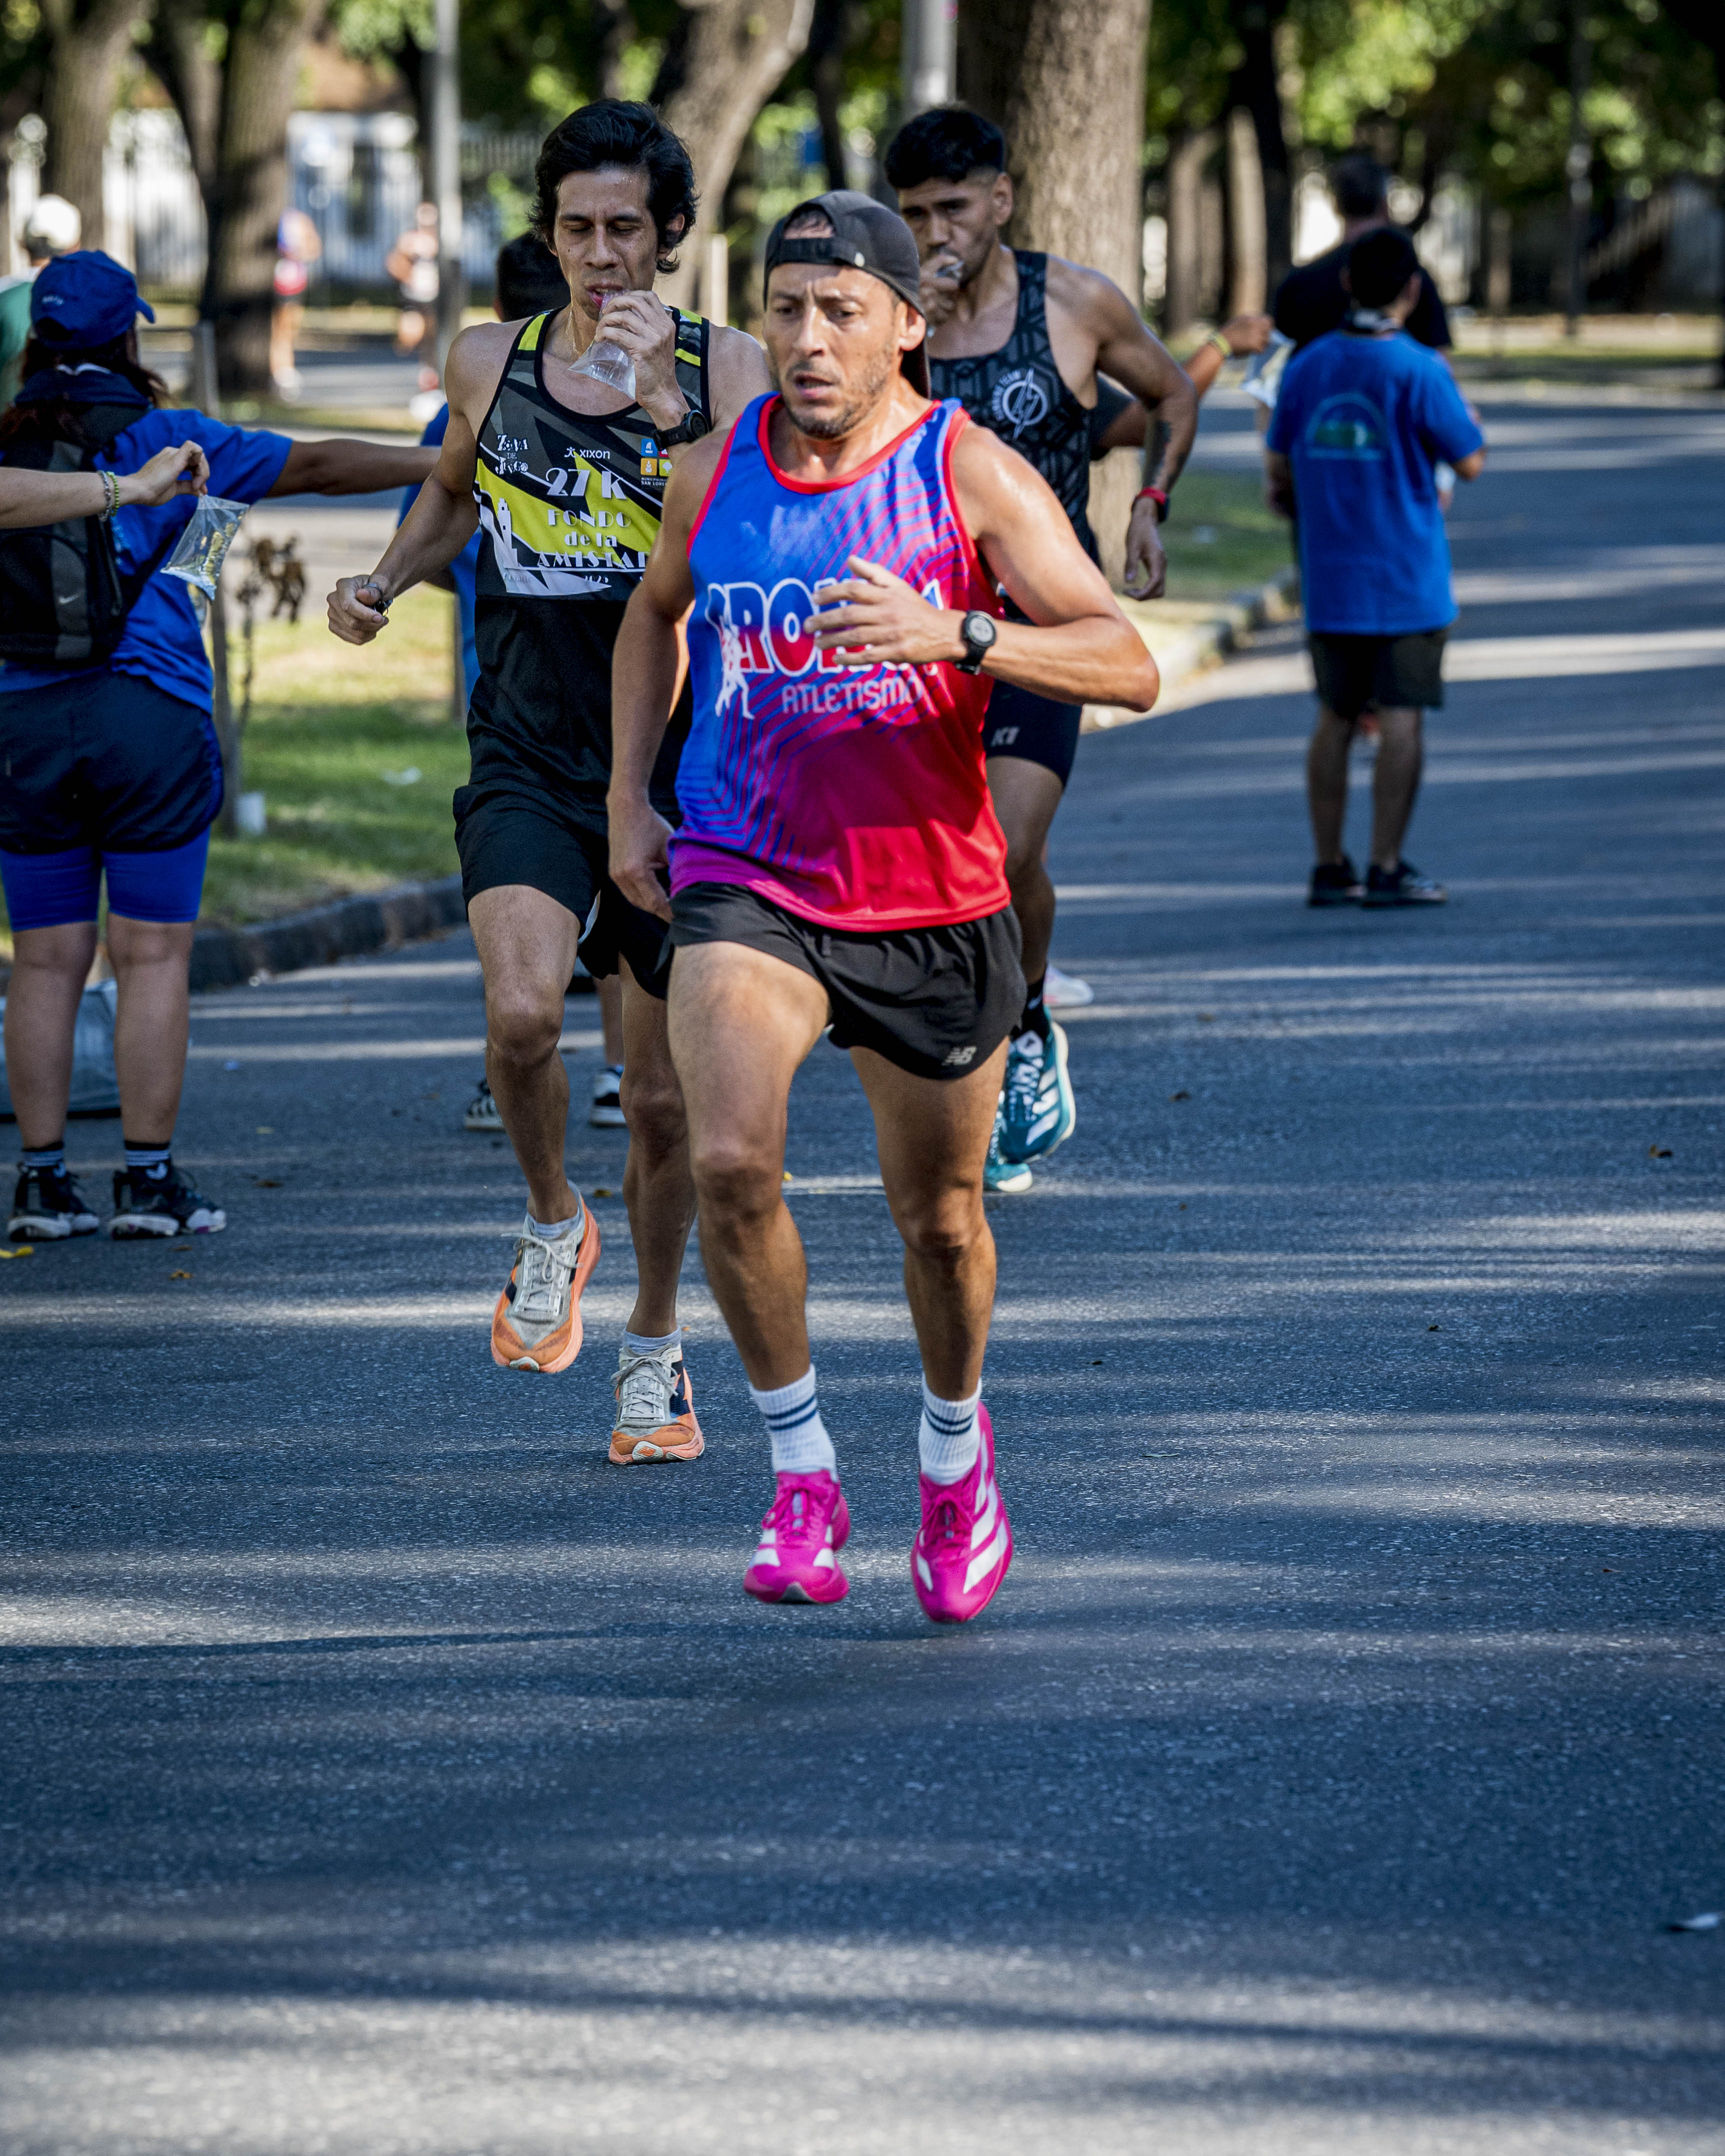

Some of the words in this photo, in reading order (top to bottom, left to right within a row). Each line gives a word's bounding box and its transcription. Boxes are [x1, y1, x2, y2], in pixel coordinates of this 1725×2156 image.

[546, 467, 590, 496] 27
[602, 470, 628, 500] K
[548, 508, 632, 527] FONDO
[564, 531, 590, 546] de
[596, 532, 618, 548] la
